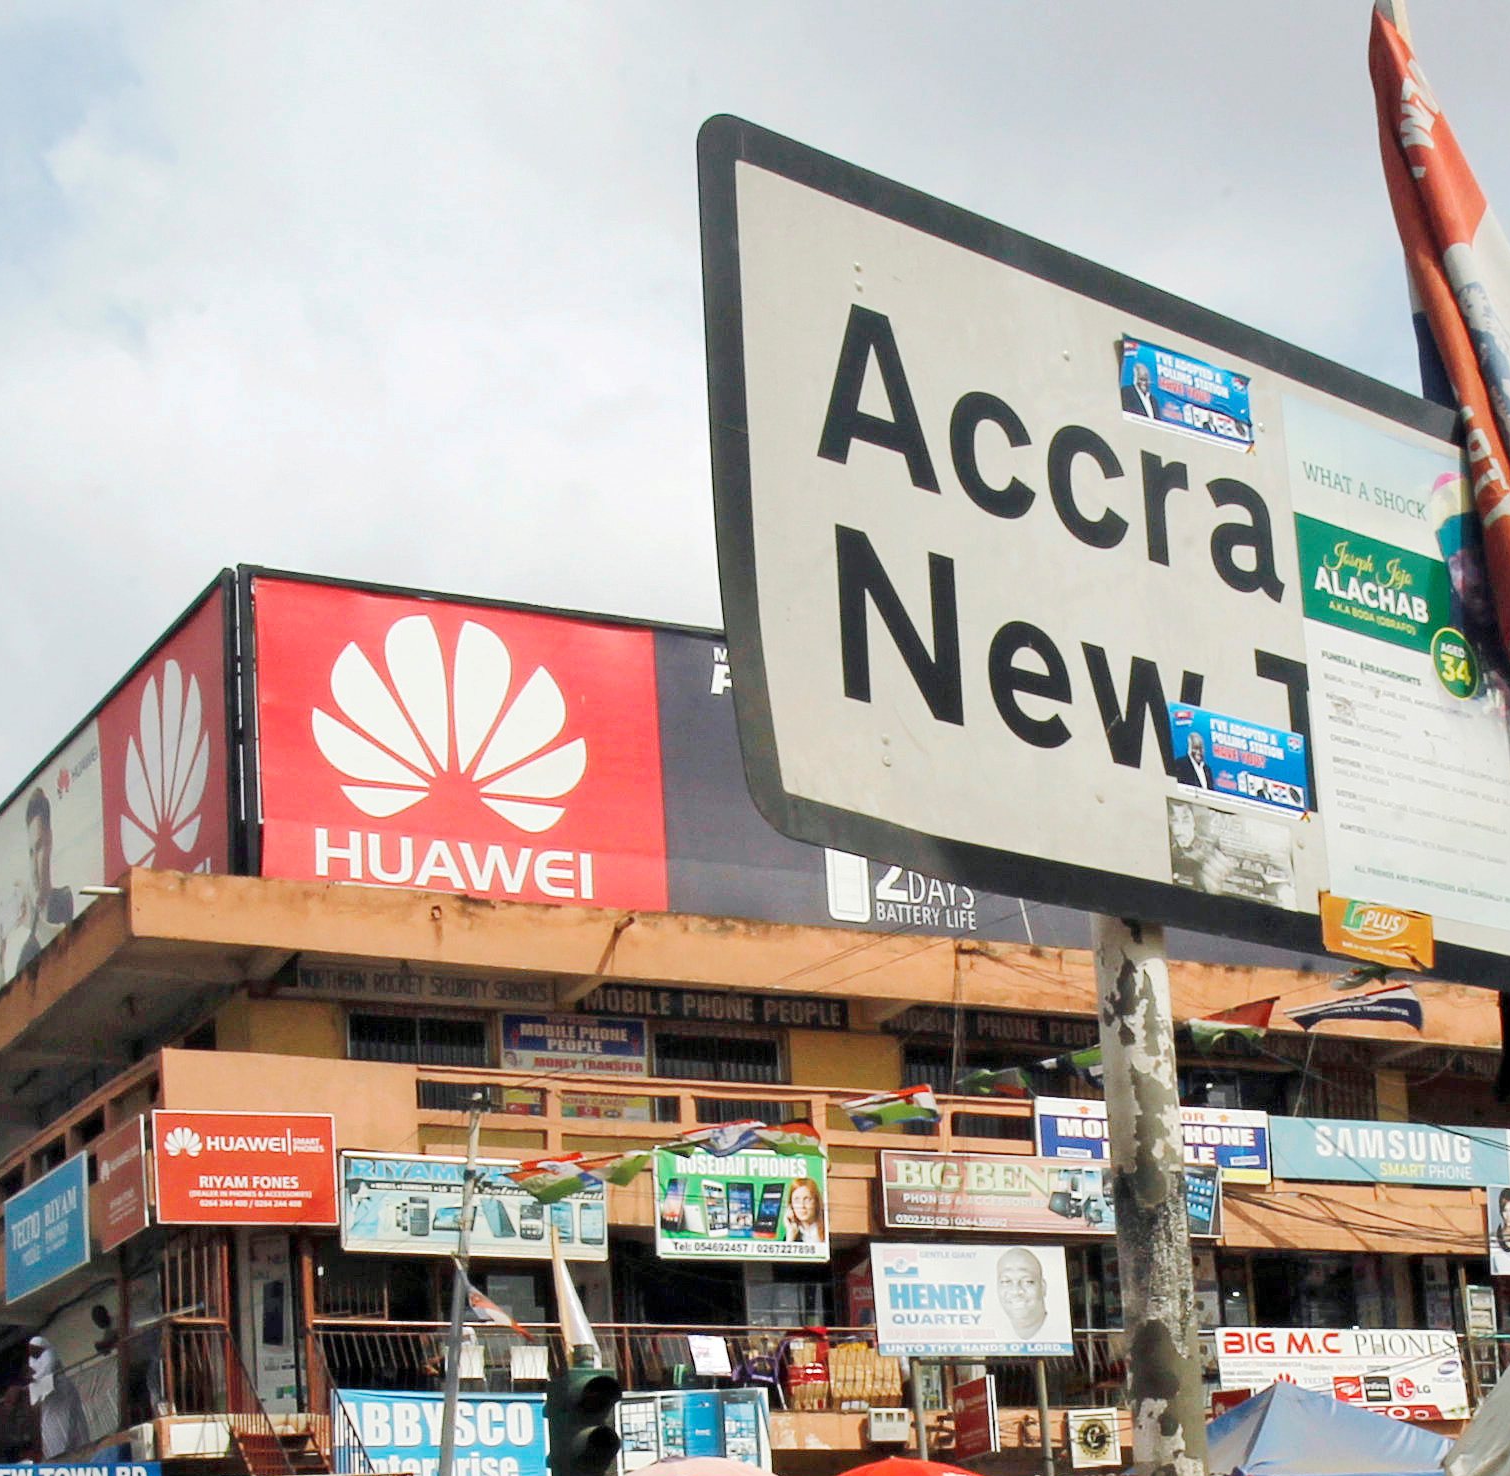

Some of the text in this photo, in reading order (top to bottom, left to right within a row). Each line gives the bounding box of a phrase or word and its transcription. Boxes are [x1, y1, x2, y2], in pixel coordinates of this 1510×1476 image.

[817, 303, 1286, 603] Accra
[1302, 461, 1428, 522] WHAT A SHOCK
[1322, 540, 1375, 577] Joseph
[1314, 565, 1430, 625] ALACHAB
[834, 522, 1205, 779] New
[1321, 649, 1358, 670] FUNERAL
[1439, 653, 1473, 687] 34
[314, 826, 595, 901] HUAWEI
[875, 902, 978, 930] BATTERY LIFE
[1363, 909, 1402, 933] PLUS
[585, 986, 841, 1027] MOBILE PHONE PEOPLE
[520, 1022, 629, 1043] MOBILE PHONE
[547, 1038, 604, 1054] PEOPLE
[533, 1056, 644, 1074] MONEY TRANSFER
[205, 1135, 287, 1153] HUAWEI
[1181, 1125, 1256, 1147] HONE
[1315, 1125, 1472, 1164] SAMSUNG
[350, 1159, 460, 1182] RIYAM
[747, 1156, 808, 1179] PHONES
[893, 1159, 1050, 1197] BIG BEN
[1379, 1161, 1473, 1181] SMART PHONE
[199, 1175, 300, 1190] RIYAM FONES
[902, 1192, 1049, 1208] PHONES & ACCESSORIES
[673, 1241, 691, 1252] Tel:
[919, 1250, 977, 1260] GENTLE GIANT
[889, 1283, 986, 1311] HENRY
[891, 1313, 982, 1325] QUARTEY
[885, 1344, 927, 1352] UNTO
[929, 1344, 958, 1352] THY
[958, 1344, 1009, 1352] HANDS
[1026, 1344, 1066, 1352] LORD.
[1223, 1332, 1458, 1357] BIG M.C PHONES
[1416, 1385, 1432, 1395] LG
